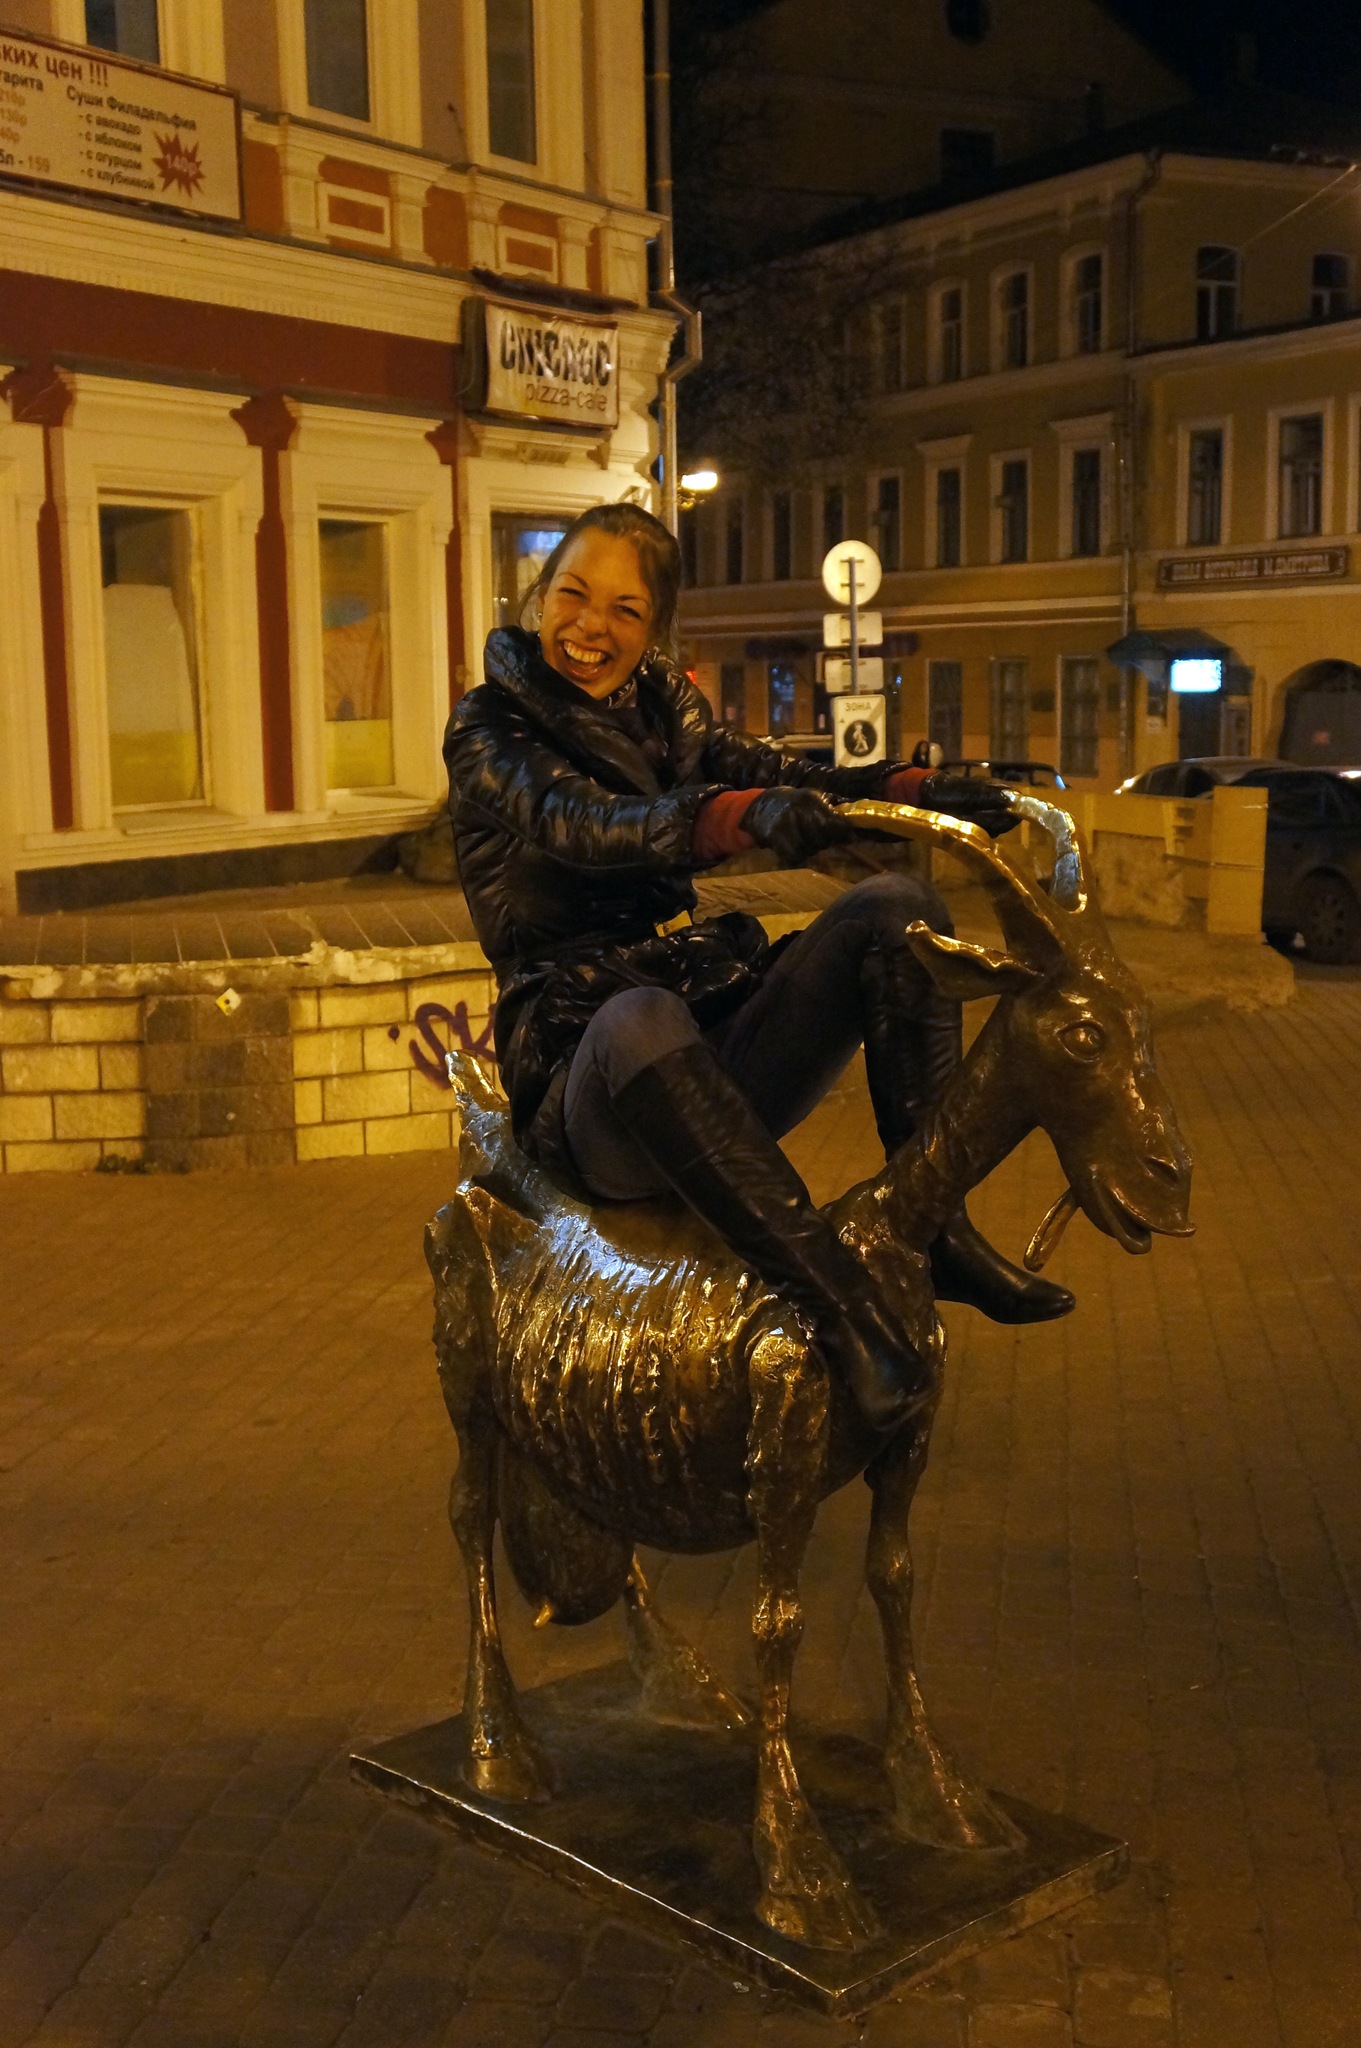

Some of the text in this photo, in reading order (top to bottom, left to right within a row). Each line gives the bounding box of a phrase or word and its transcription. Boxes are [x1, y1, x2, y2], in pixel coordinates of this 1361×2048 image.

[45, 56, 83, 81] цен
[89, 62, 108, 88] !!!
[66, 85, 197, 132] Суши Филадельфия
[94, 132, 143, 153] яблоком
[95, 151, 143, 170] огурцом
[96, 170, 155, 191] клубникой
[844, 702, 872, 712] ЗОНА
